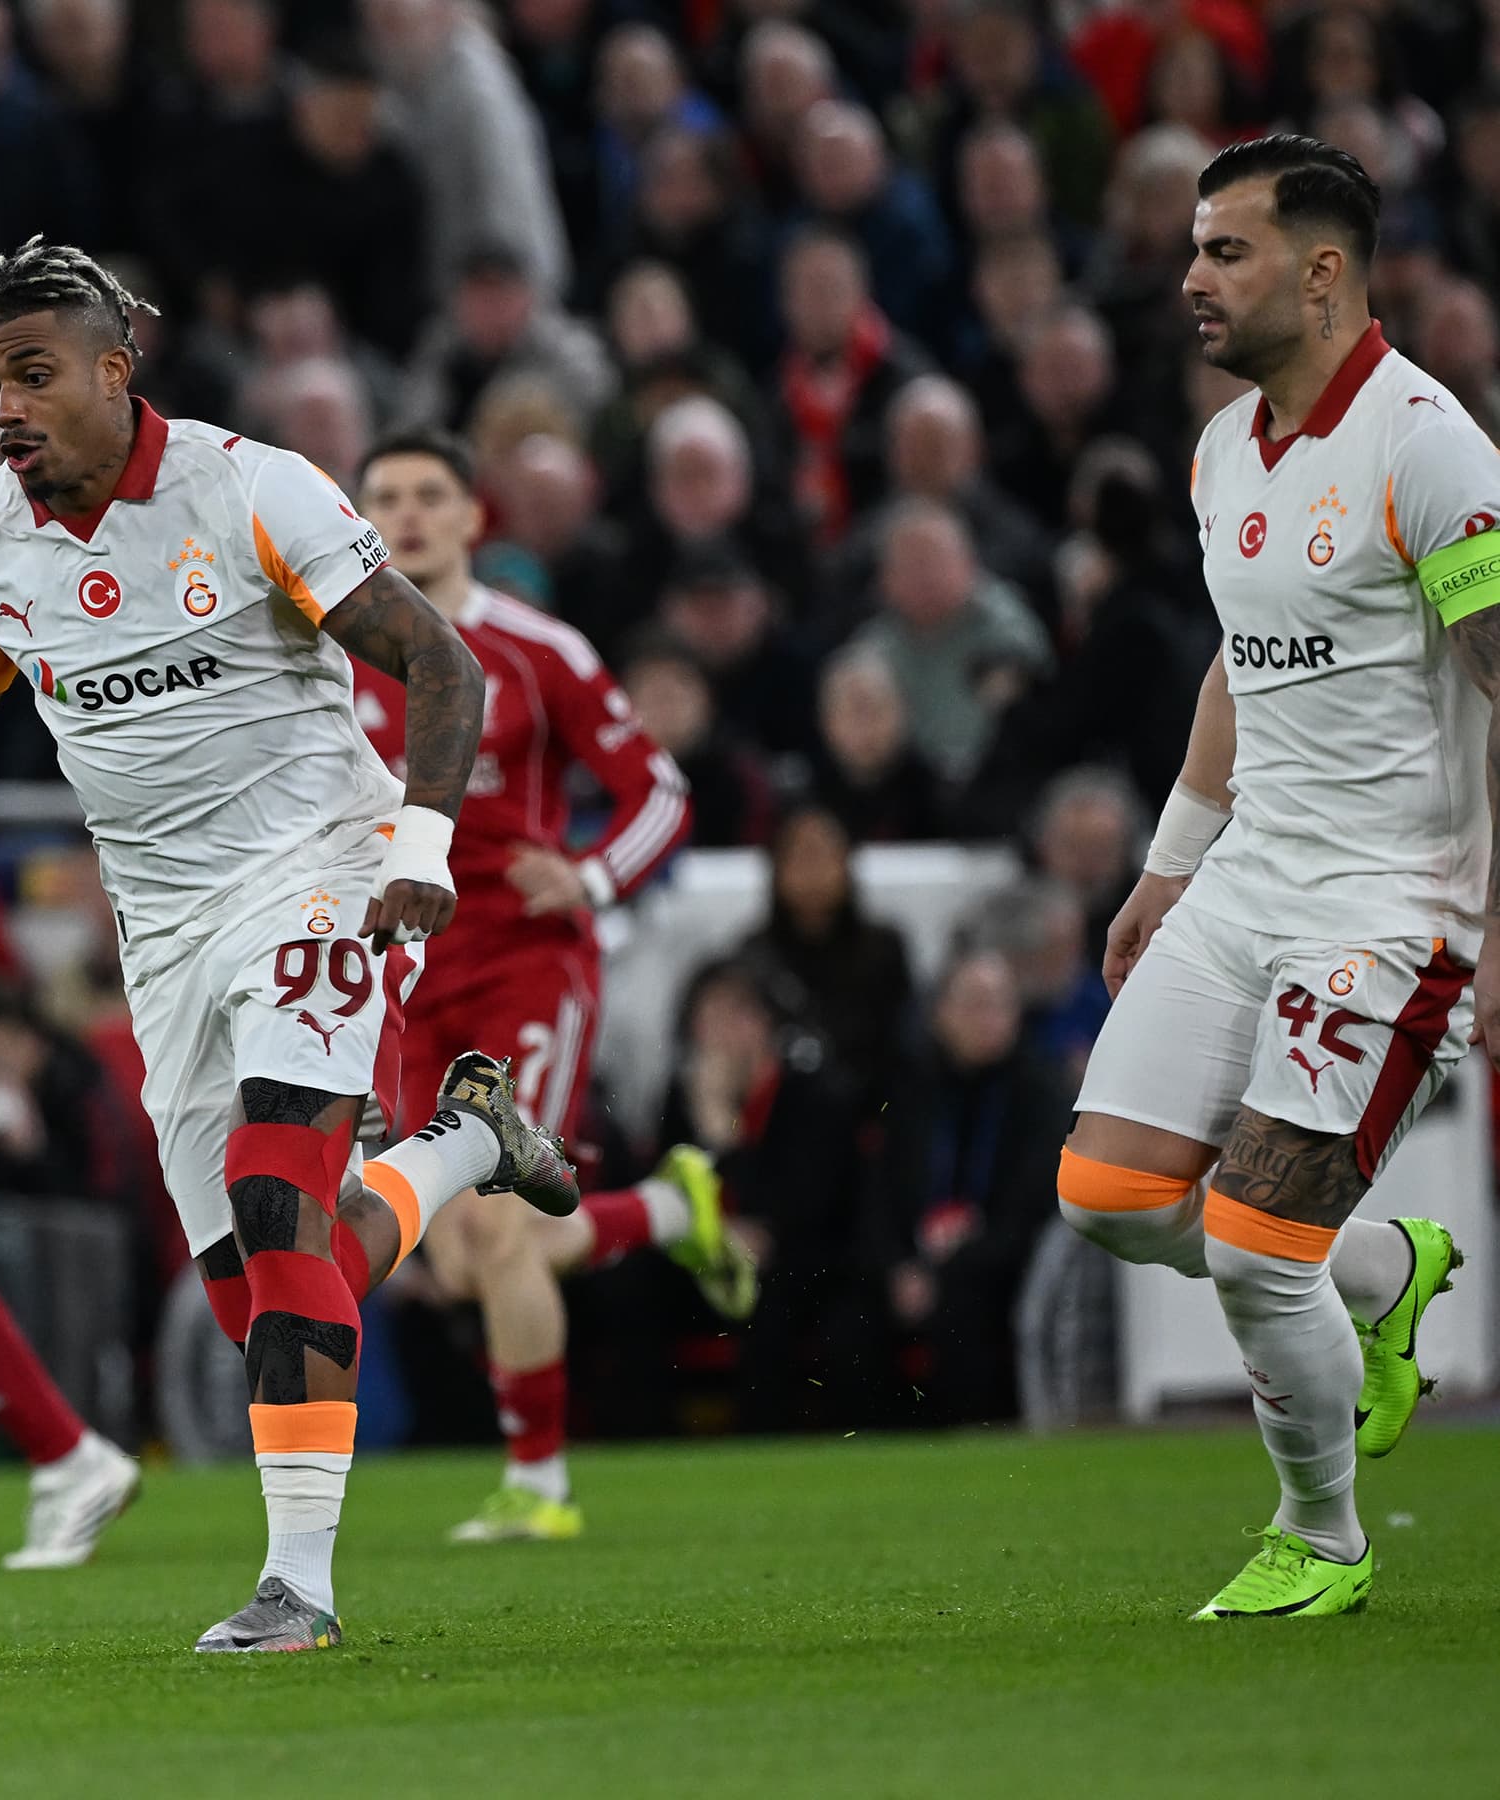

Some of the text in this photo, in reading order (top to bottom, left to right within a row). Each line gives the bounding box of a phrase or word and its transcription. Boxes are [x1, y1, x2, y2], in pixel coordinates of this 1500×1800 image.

[1442, 559, 1500, 593] RESPEC
[1232, 633, 1337, 670] SOCAR
[75, 655, 223, 711] SOCAR
[274, 938, 374, 1018] 99
[1277, 984, 1370, 1066] 42
